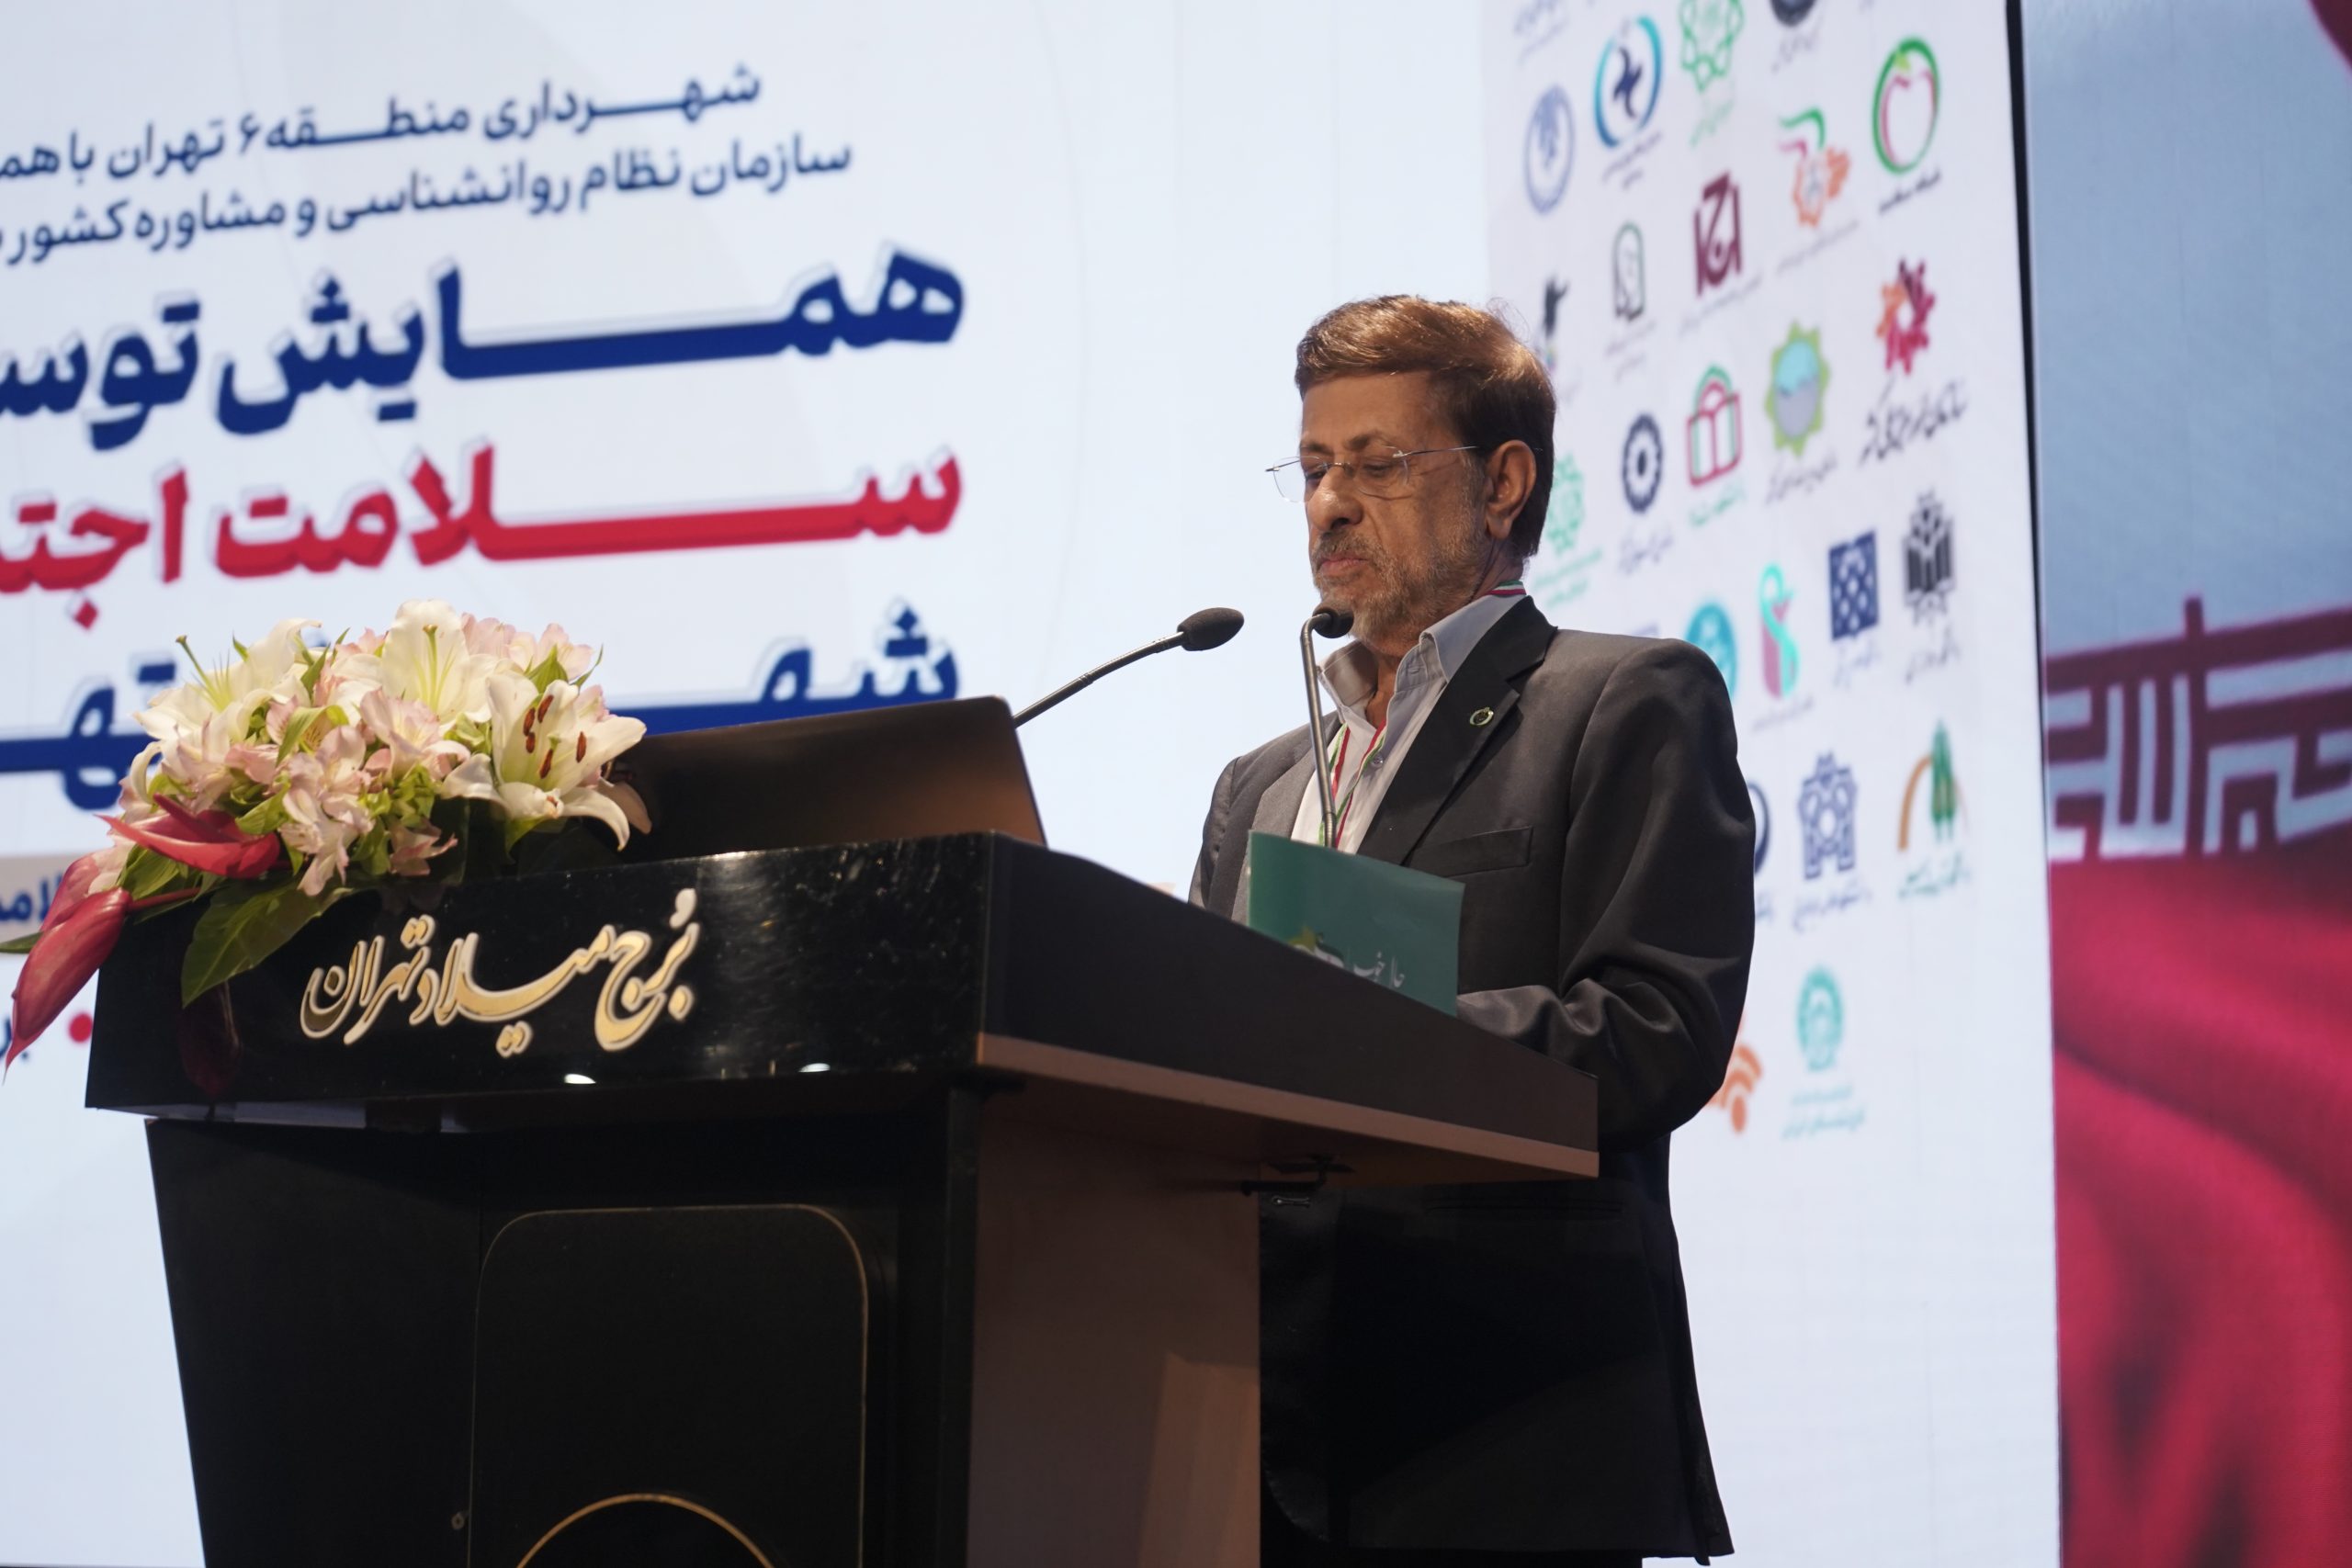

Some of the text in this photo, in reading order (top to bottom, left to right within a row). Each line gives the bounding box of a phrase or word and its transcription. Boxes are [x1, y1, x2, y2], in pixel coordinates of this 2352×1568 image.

[483, 62, 761, 140] شهرداری
[0, 144, 61, 179] هم
[69, 130, 95, 185] با
[107, 118, 226, 179] تهران
[581, 148, 682, 211] نظام
[691, 132, 851, 197] سازمان
[6, 198, 131, 266] کشور
[134, 190, 286, 252] مشاوره
[296, 197, 317, 239] و
[0, 243, 966, 451] همایش توس
[0, 443, 963, 630] سلامت اجت
[300, 914, 435, 1045] تهران
[409, 923, 617, 1058] میلاد
